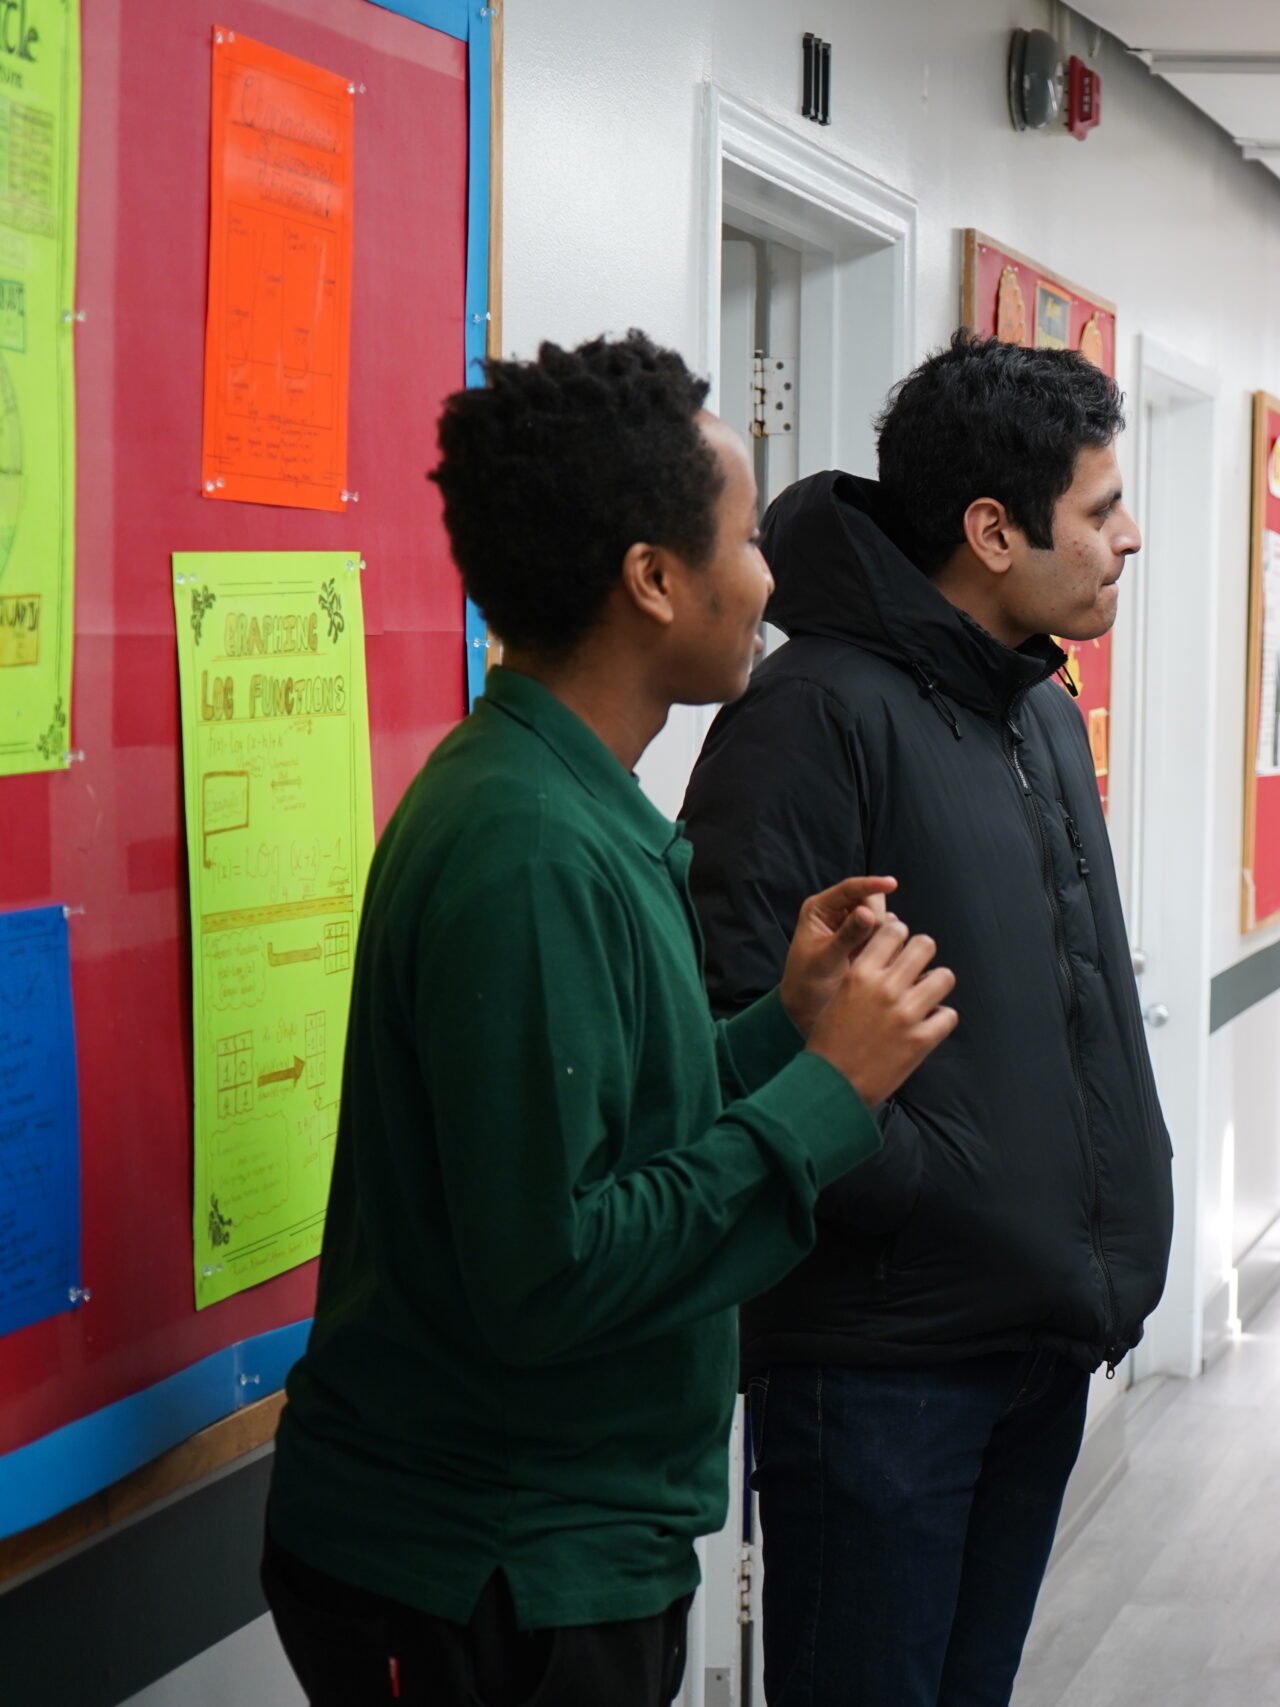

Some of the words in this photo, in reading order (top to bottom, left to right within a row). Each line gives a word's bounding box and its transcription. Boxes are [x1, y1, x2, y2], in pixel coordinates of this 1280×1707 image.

[224, 612, 319, 657] GRAPHING
[201, 670, 235, 721] LOG
[249, 674, 346, 719] FUNCTIONS
